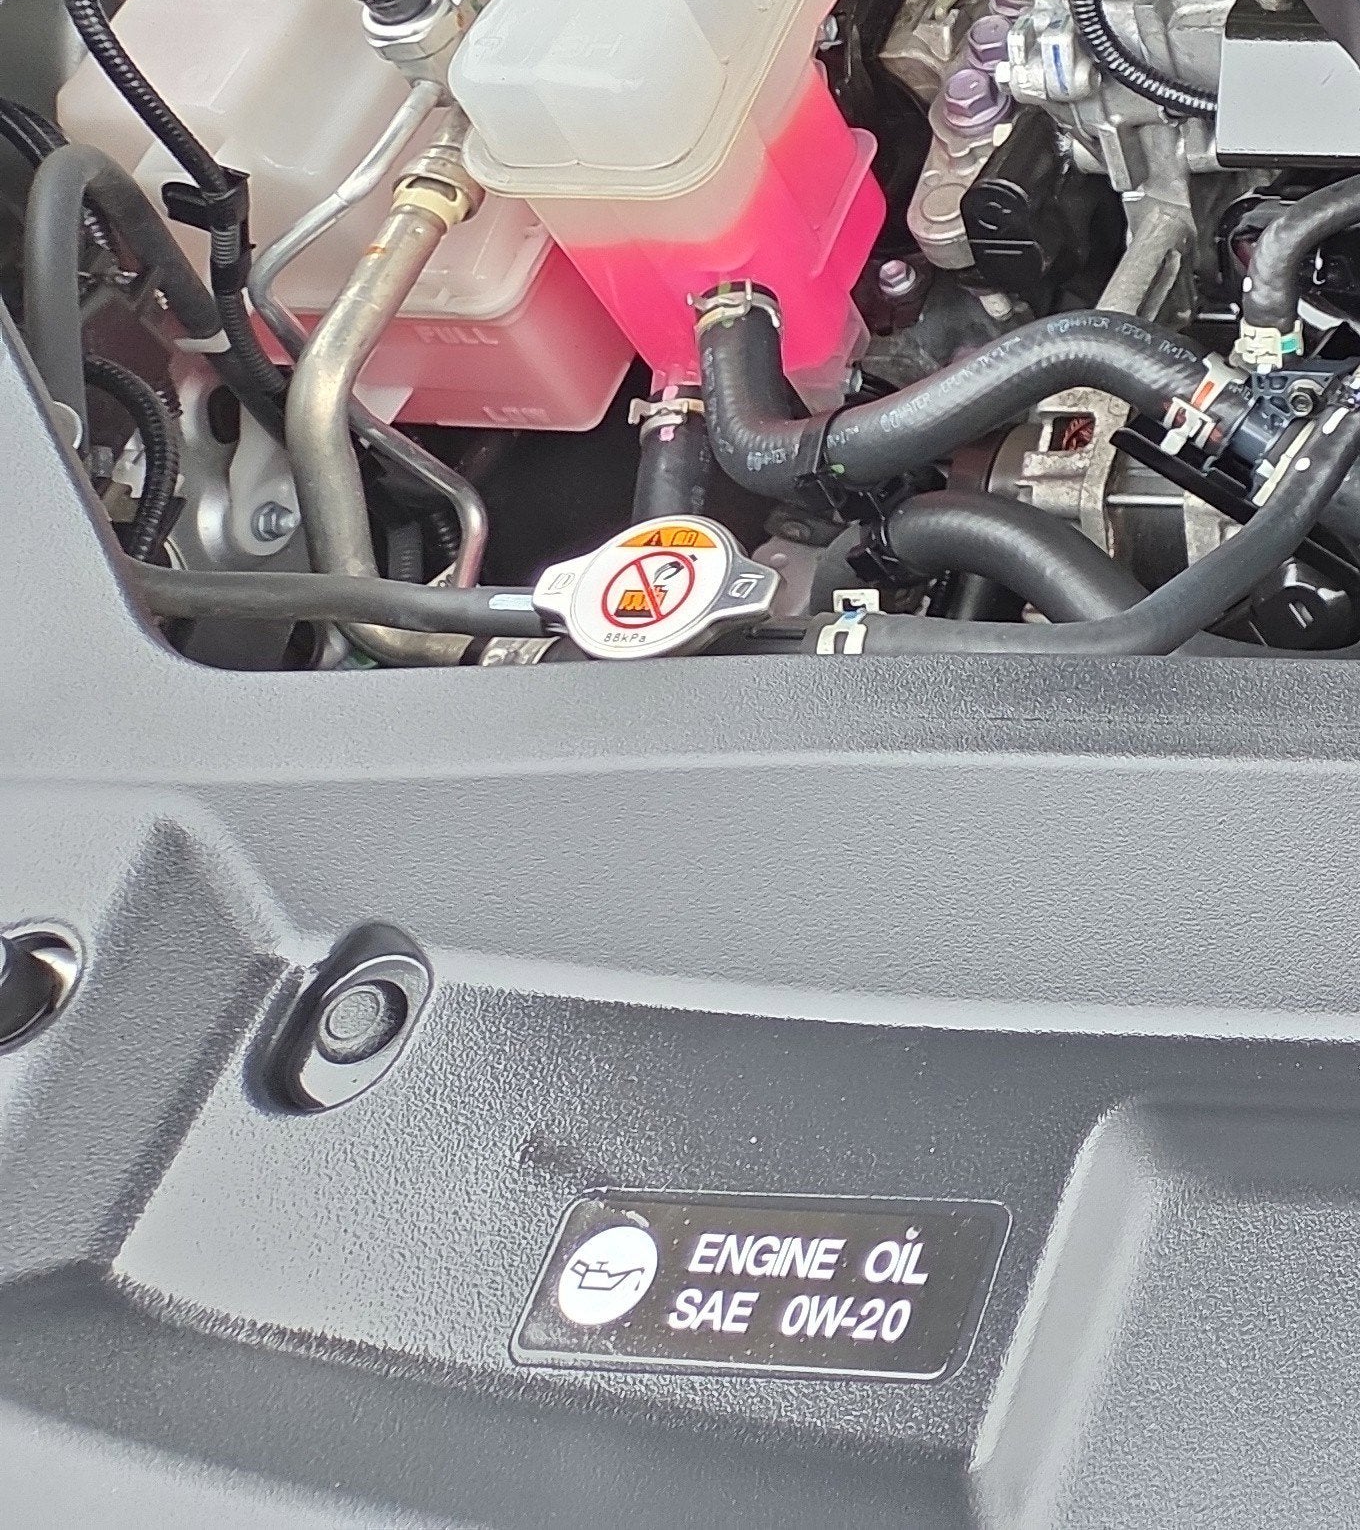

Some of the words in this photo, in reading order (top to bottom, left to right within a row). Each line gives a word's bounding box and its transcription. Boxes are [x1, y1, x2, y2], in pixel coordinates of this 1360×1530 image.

[414, 326, 499, 345] FULL
[604, 632, 647, 643] 88kPa
[687, 1232, 847, 1280] ENGINE
[863, 1239, 929, 1286] OIL
[668, 1288, 760, 1333] SAE
[780, 1295, 913, 1344] 0W-20
